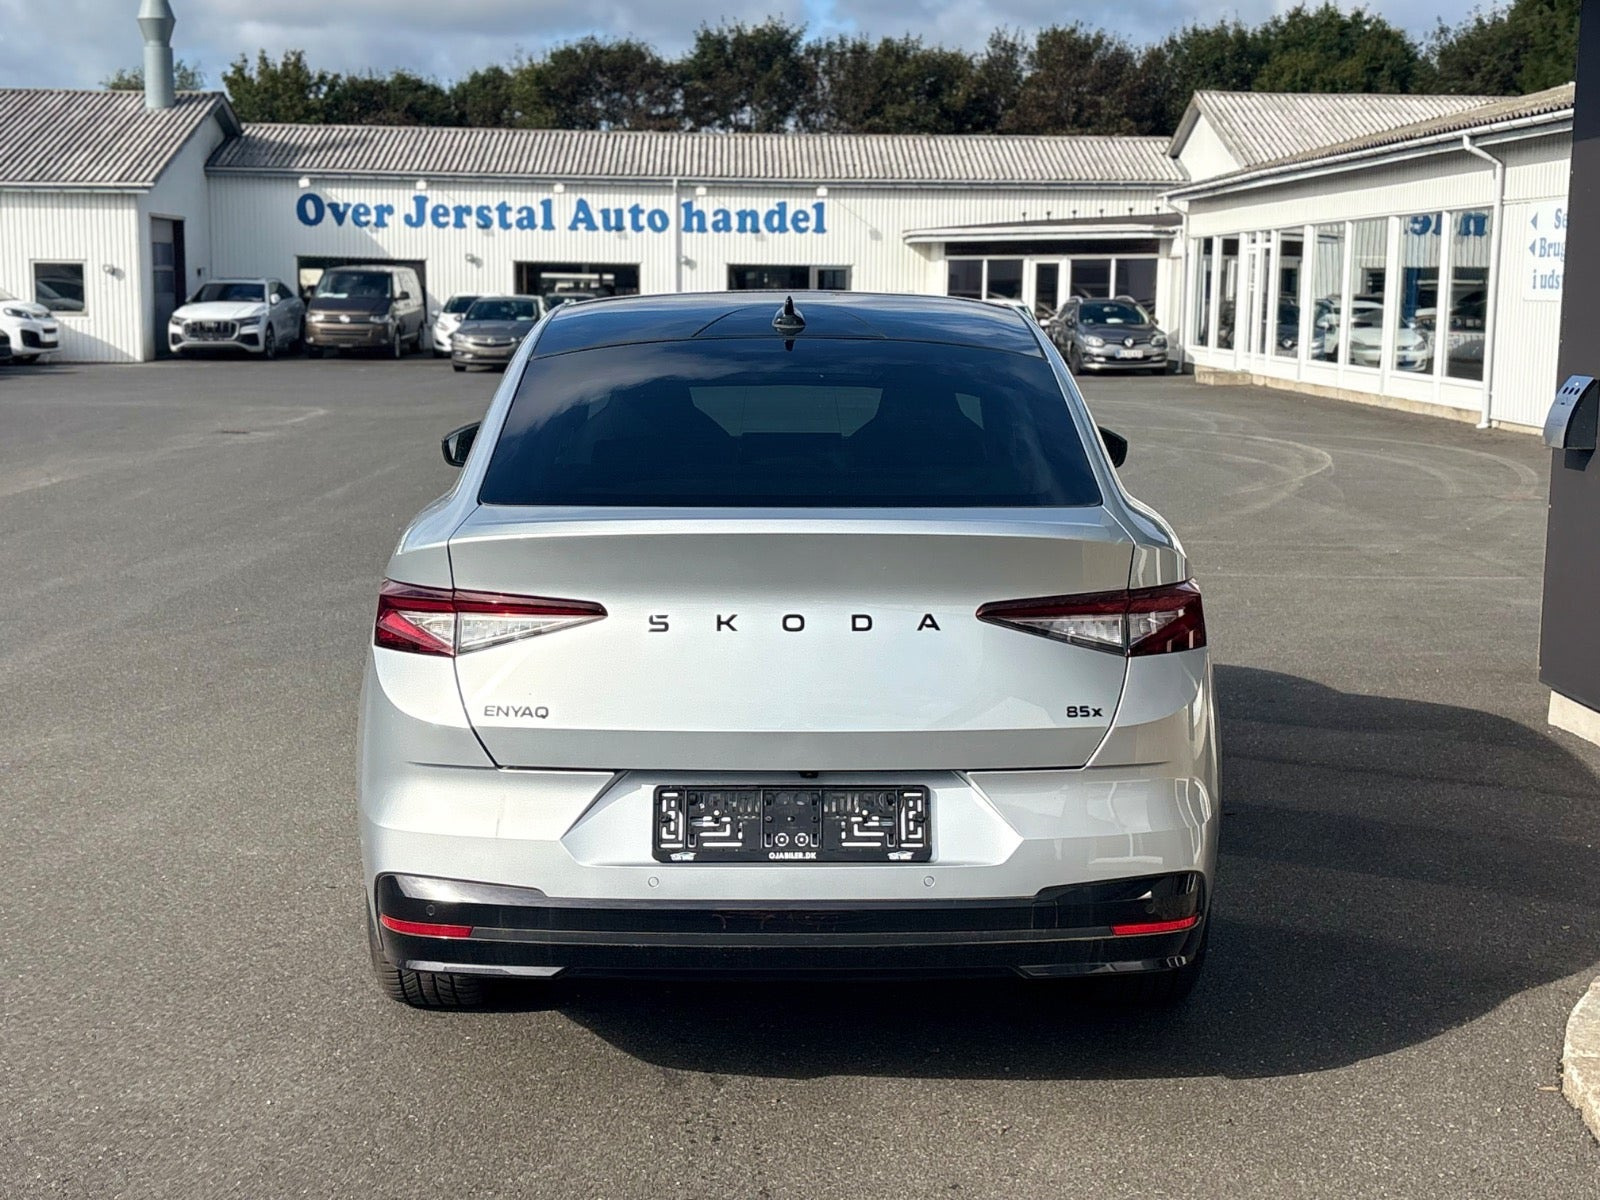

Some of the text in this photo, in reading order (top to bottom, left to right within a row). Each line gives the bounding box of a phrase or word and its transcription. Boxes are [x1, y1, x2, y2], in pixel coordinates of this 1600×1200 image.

[295, 193, 394, 228] Over
[404, 195, 554, 231] Jerstal
[568, 198, 670, 233] Auto
[1532, 268, 1563, 290] i uds
[484, 705, 549, 719] ENYAQ
